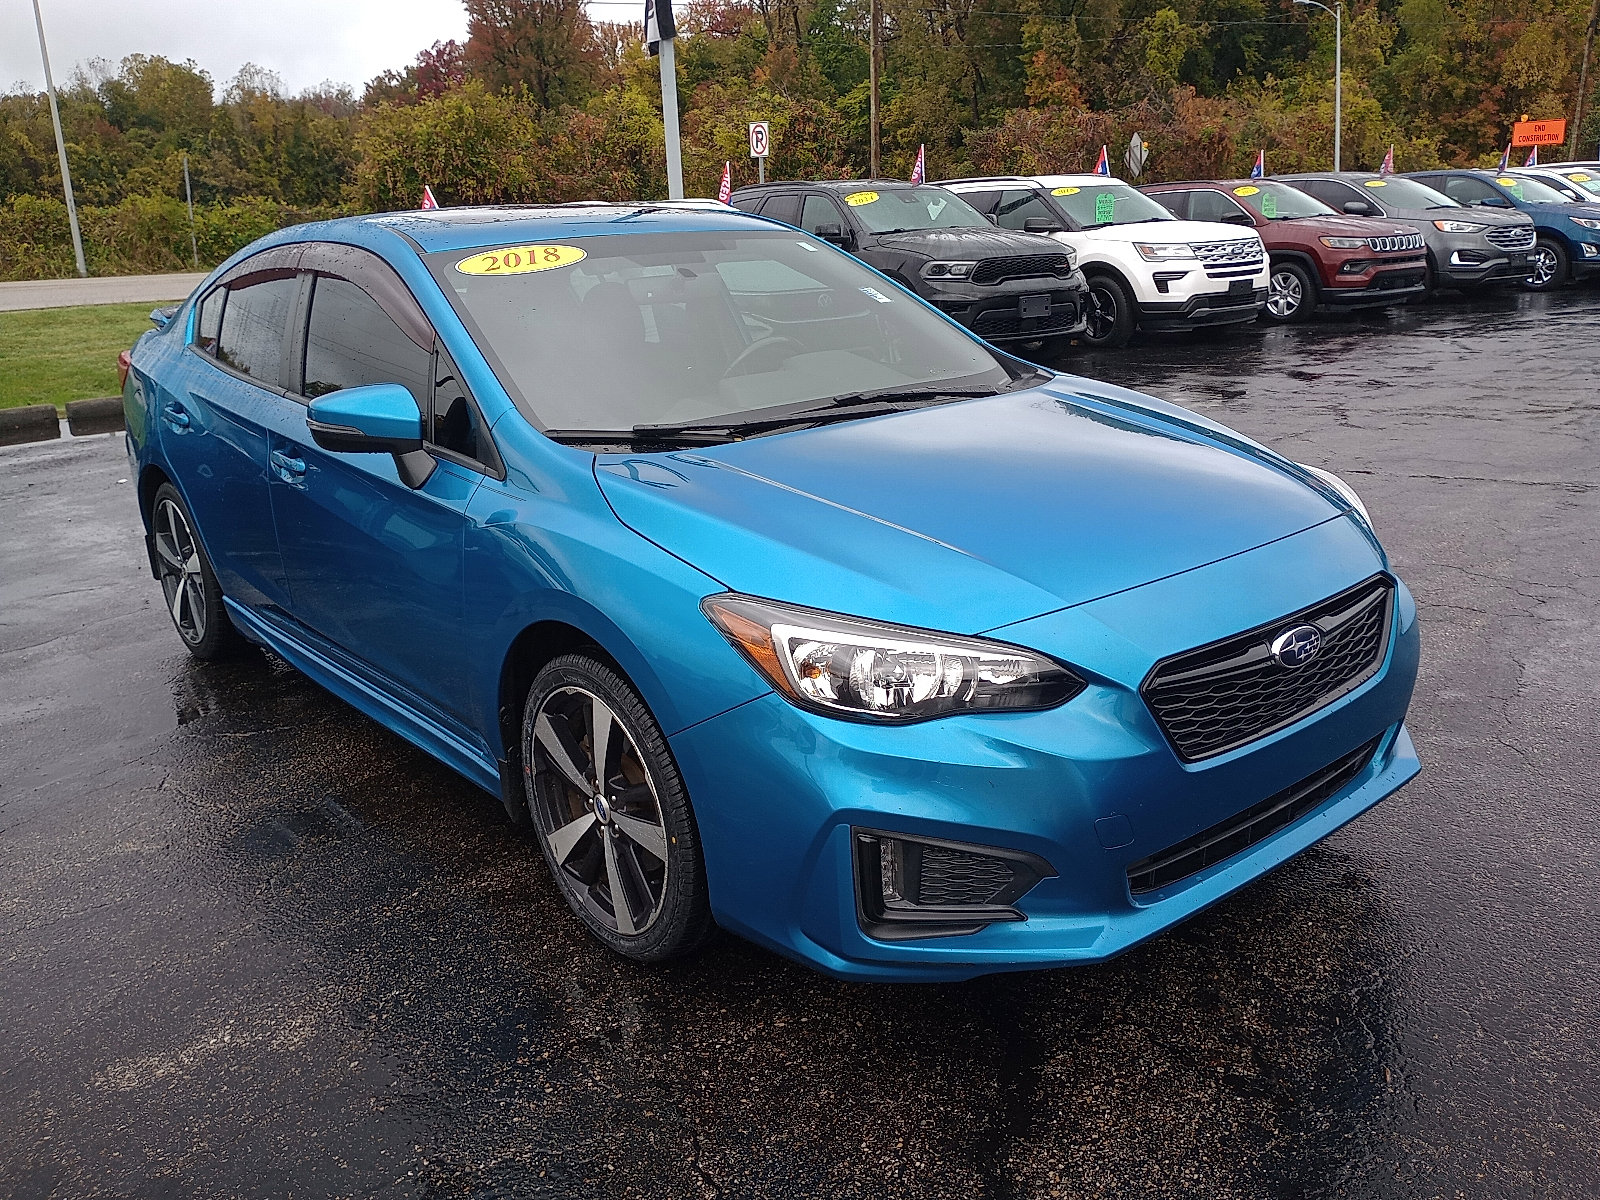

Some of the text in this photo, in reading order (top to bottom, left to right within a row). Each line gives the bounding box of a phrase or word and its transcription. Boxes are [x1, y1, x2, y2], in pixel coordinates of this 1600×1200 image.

[1534, 124, 1546, 132] END
[1518, 133, 1560, 143] CONSTRUCTION
[481, 247, 561, 272] 2018
